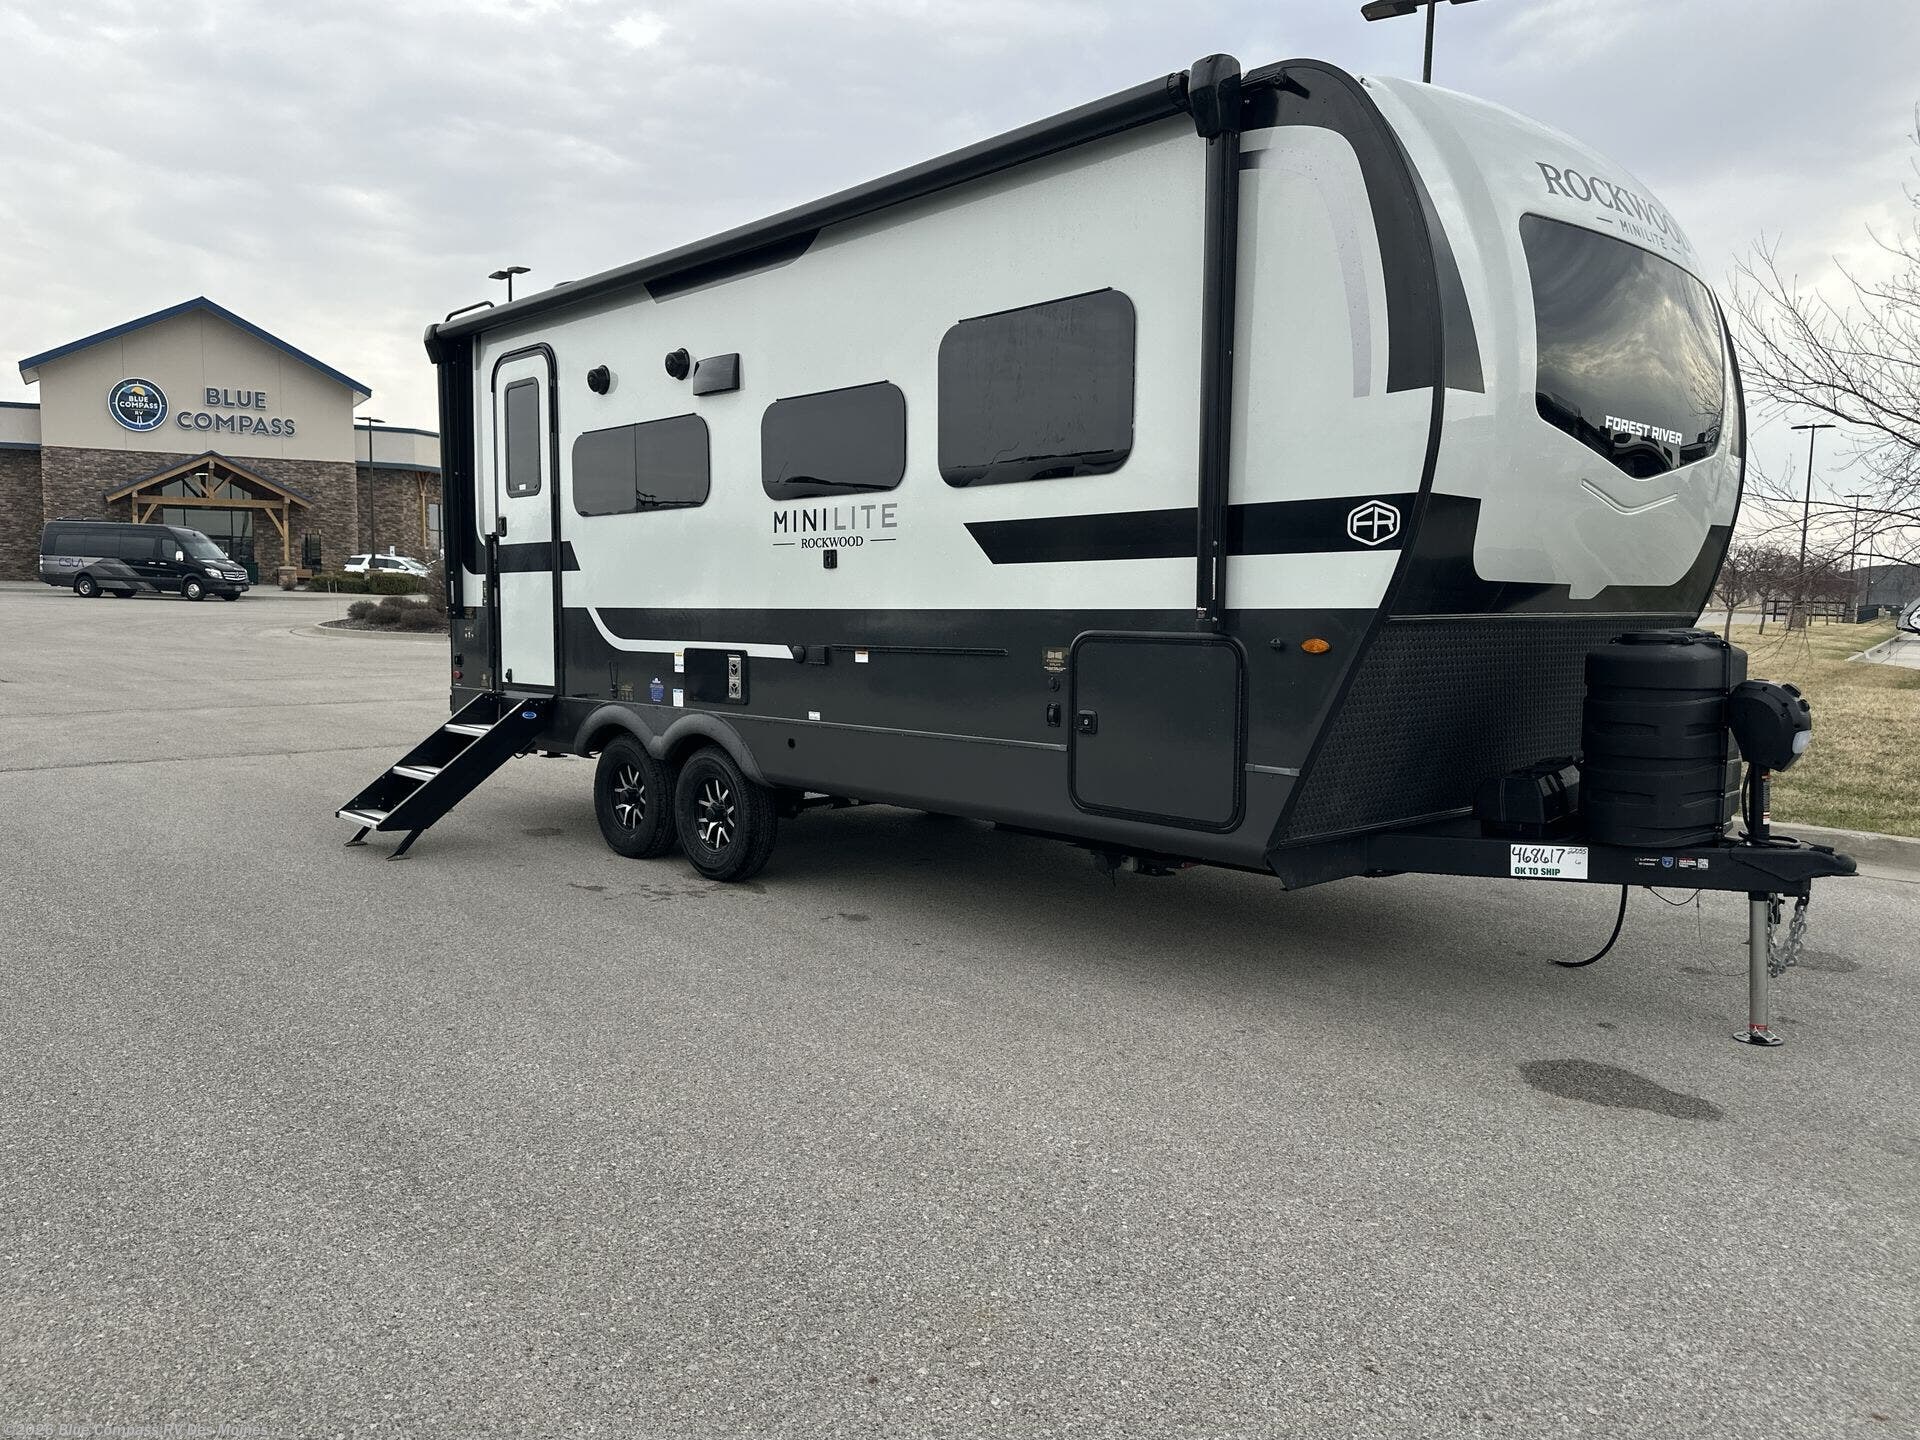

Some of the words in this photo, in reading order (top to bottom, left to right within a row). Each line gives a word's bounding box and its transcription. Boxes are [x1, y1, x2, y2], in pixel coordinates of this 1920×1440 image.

[1535, 161, 1691, 253] ROCKWOOD
[1618, 218, 1668, 250] MINILITE
[119, 401, 159, 410] COMPASS
[128, 395, 149, 403] BLUE
[205, 387, 267, 409] BLUE
[176, 411, 297, 436] COMPASS
[1605, 415, 1651, 437] FOREST
[1651, 426, 1683, 445] RIVER
[773, 503, 898, 534] MINILITE
[801, 536, 864, 549] ROCKWOOD
[1512, 846, 1566, 864] 468617
[1514, 866, 1527, 875] OK
[1528, 867, 1539, 876] TO
[1540, 868, 1561, 876] SHIP
